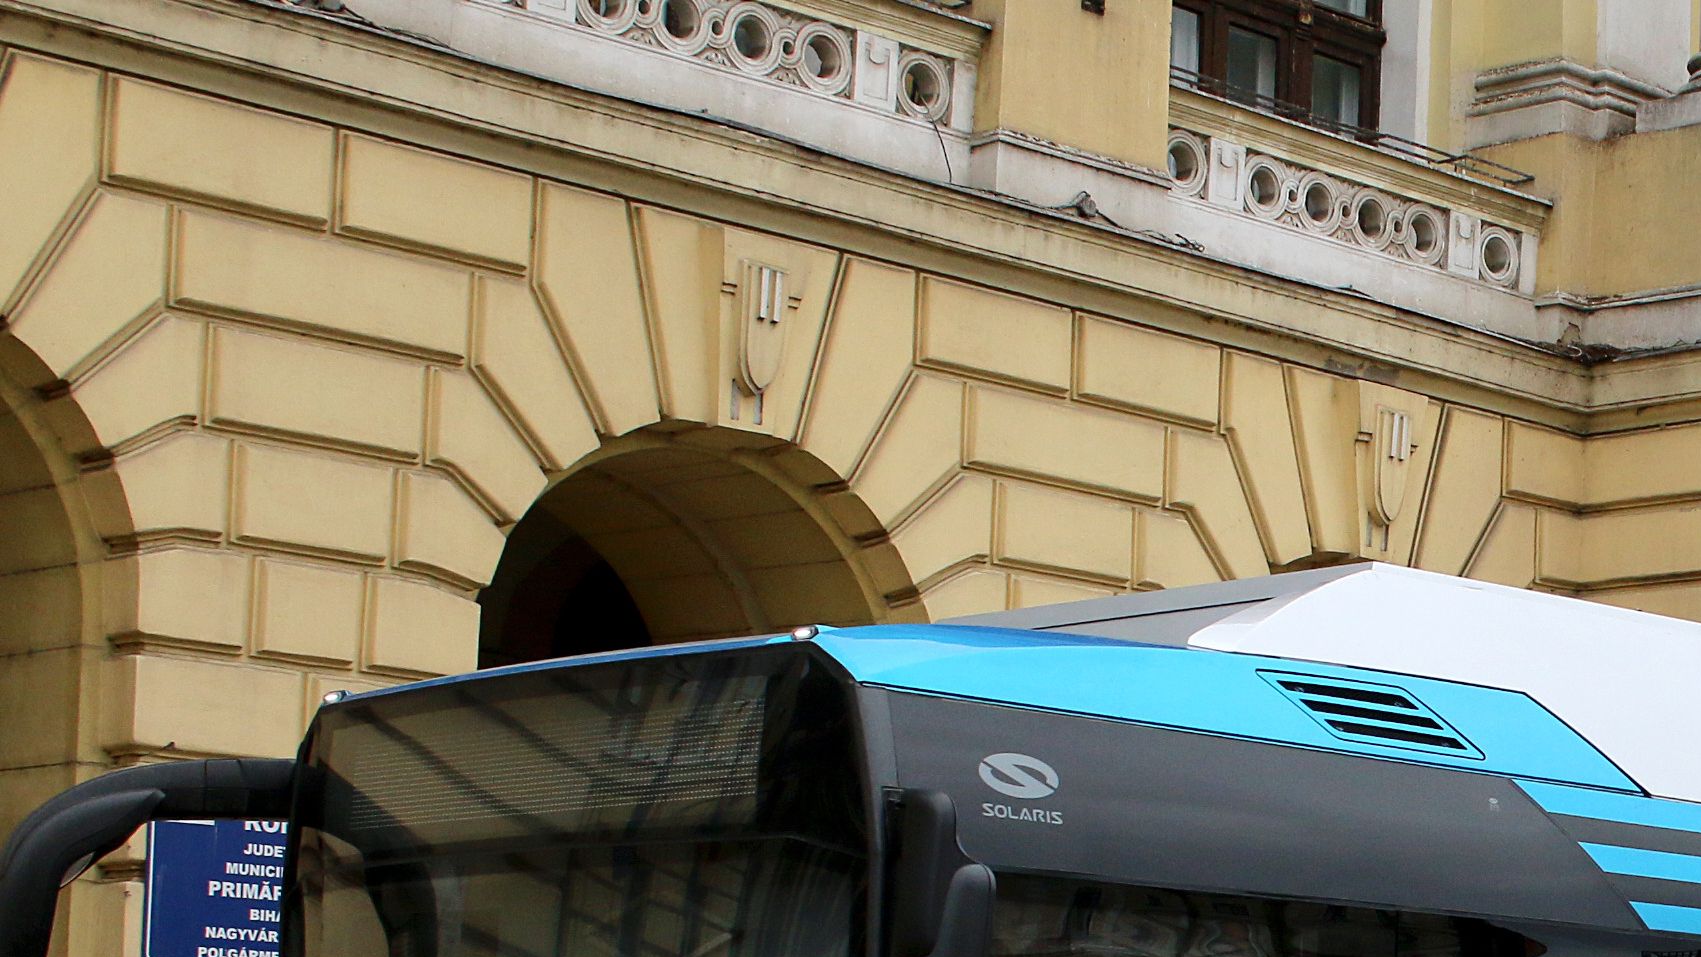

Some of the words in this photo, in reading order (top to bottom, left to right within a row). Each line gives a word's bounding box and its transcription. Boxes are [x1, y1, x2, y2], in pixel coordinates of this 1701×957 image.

[982, 802, 1064, 825] SOLARIS
[244, 843, 286, 858] JUDE
[224, 862, 284, 878] MUNICI
[205, 926, 279, 943] NAGYVÁR
